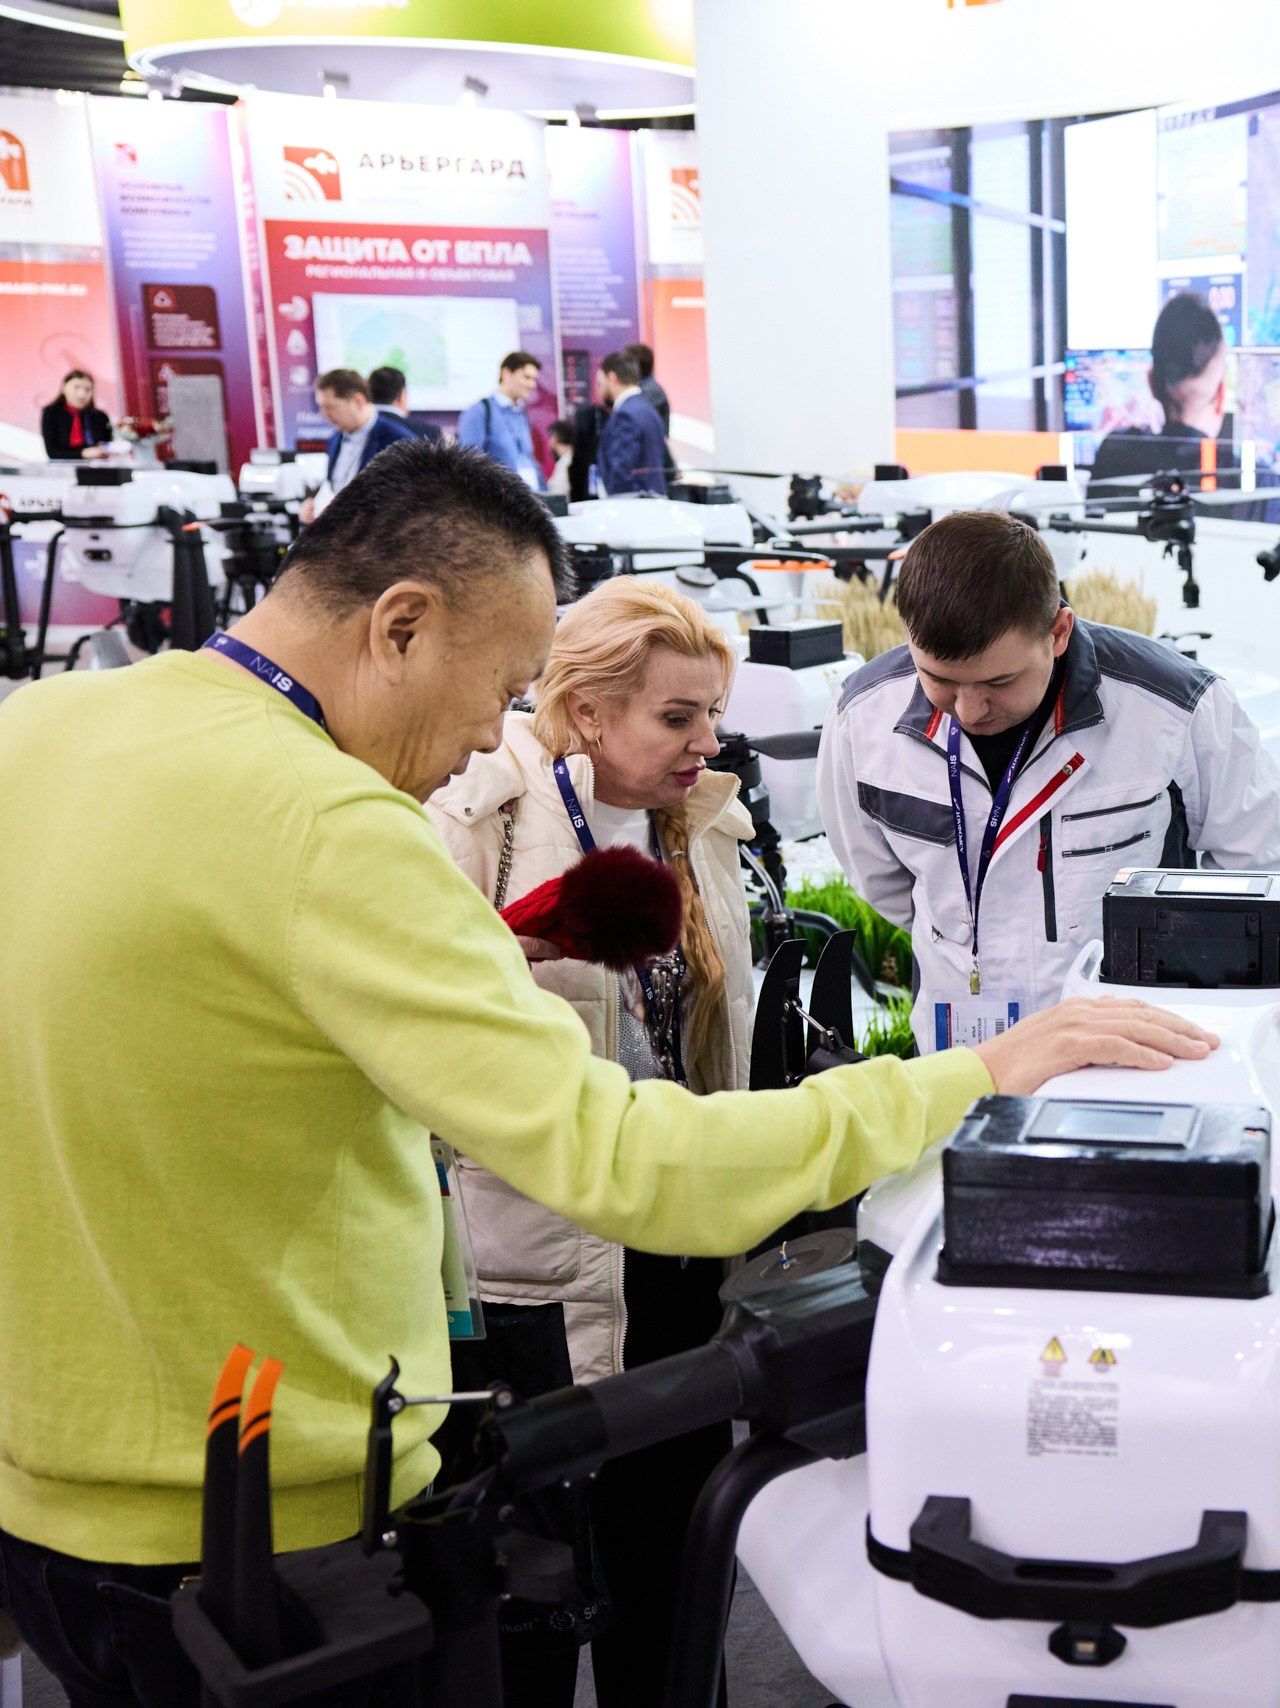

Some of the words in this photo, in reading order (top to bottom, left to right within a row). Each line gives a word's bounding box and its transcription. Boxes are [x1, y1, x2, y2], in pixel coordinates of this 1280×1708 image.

[359, 153, 527, 179] АРЬЕРГАРД
[283, 234, 410, 264] ЗАЩИТА
[411, 238, 452, 264] ОТ
[454, 240, 533, 266] БПЛА
[305, 264, 415, 280] РЕГИОНАЛЬНАЯ
[249, 655, 293, 691] NAIS
[566, 798, 585, 829] NAIS
[990, 805, 1001, 828] NAIS
[955, 811, 964, 853] АЭРОФЛОТ
